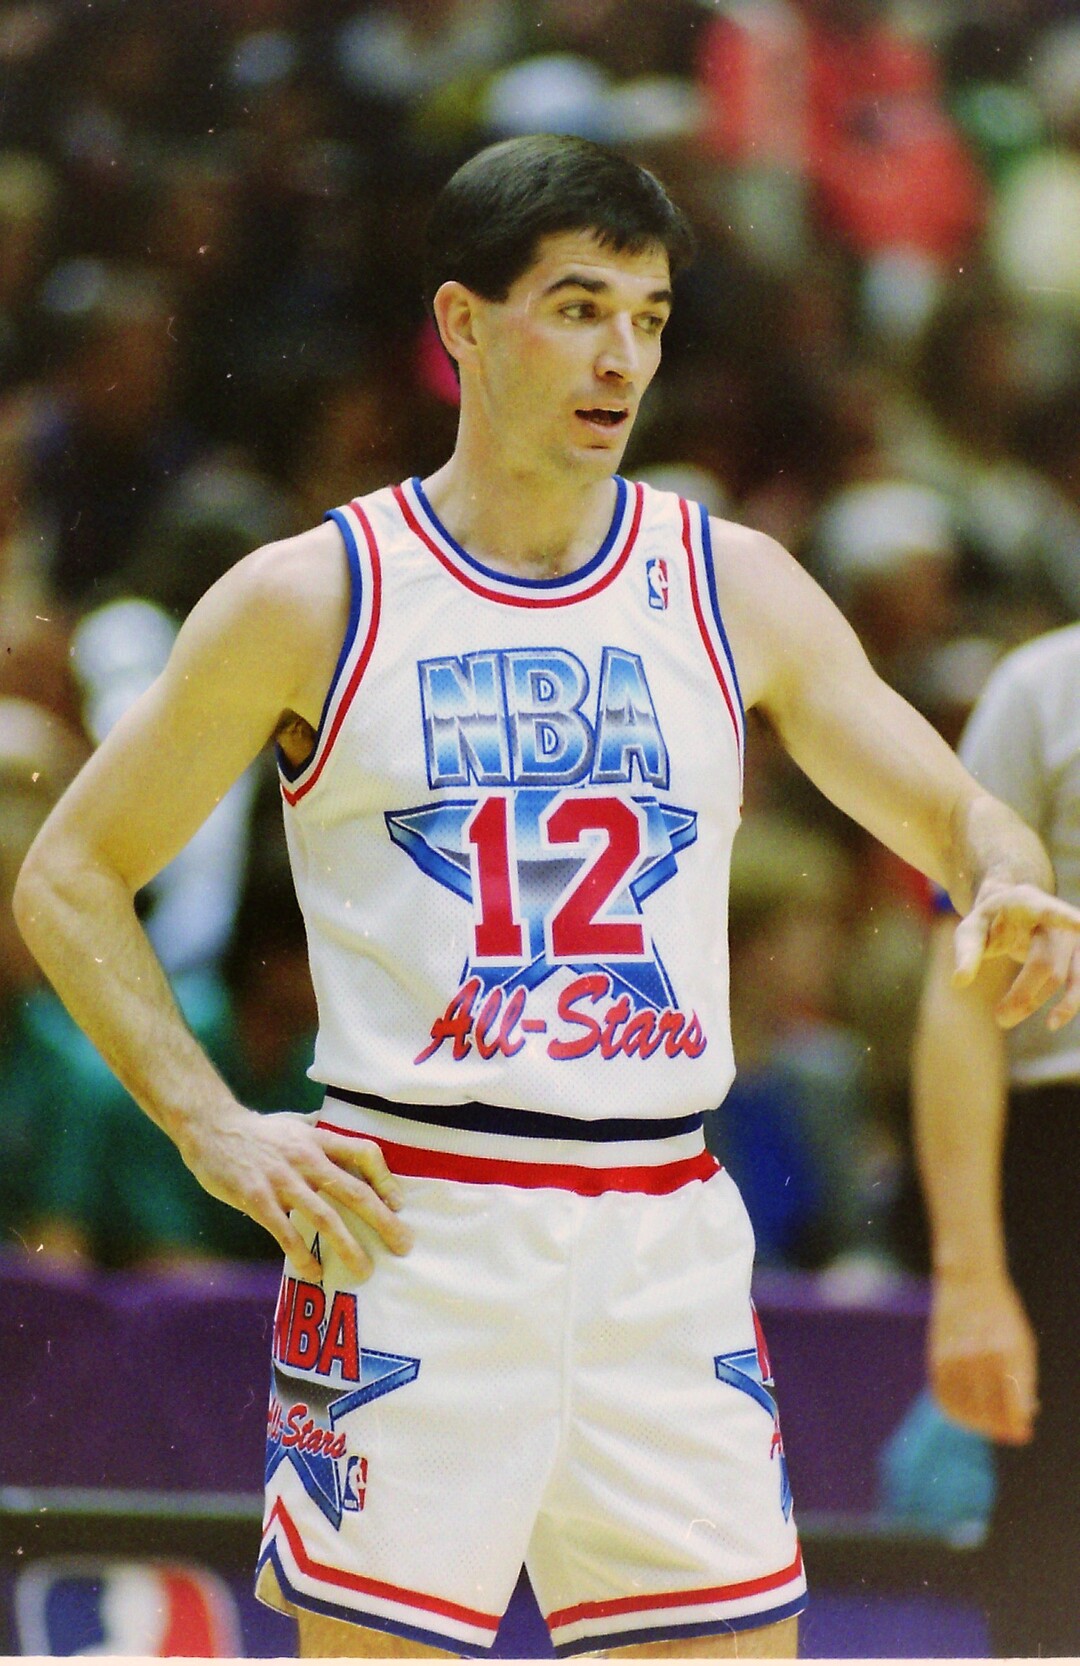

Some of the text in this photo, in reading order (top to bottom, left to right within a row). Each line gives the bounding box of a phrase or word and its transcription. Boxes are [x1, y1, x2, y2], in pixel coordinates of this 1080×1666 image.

[417, 646, 670, 790] NBA
[469, 796, 645, 957] 12
[413, 974, 708, 1066] All-Stars
